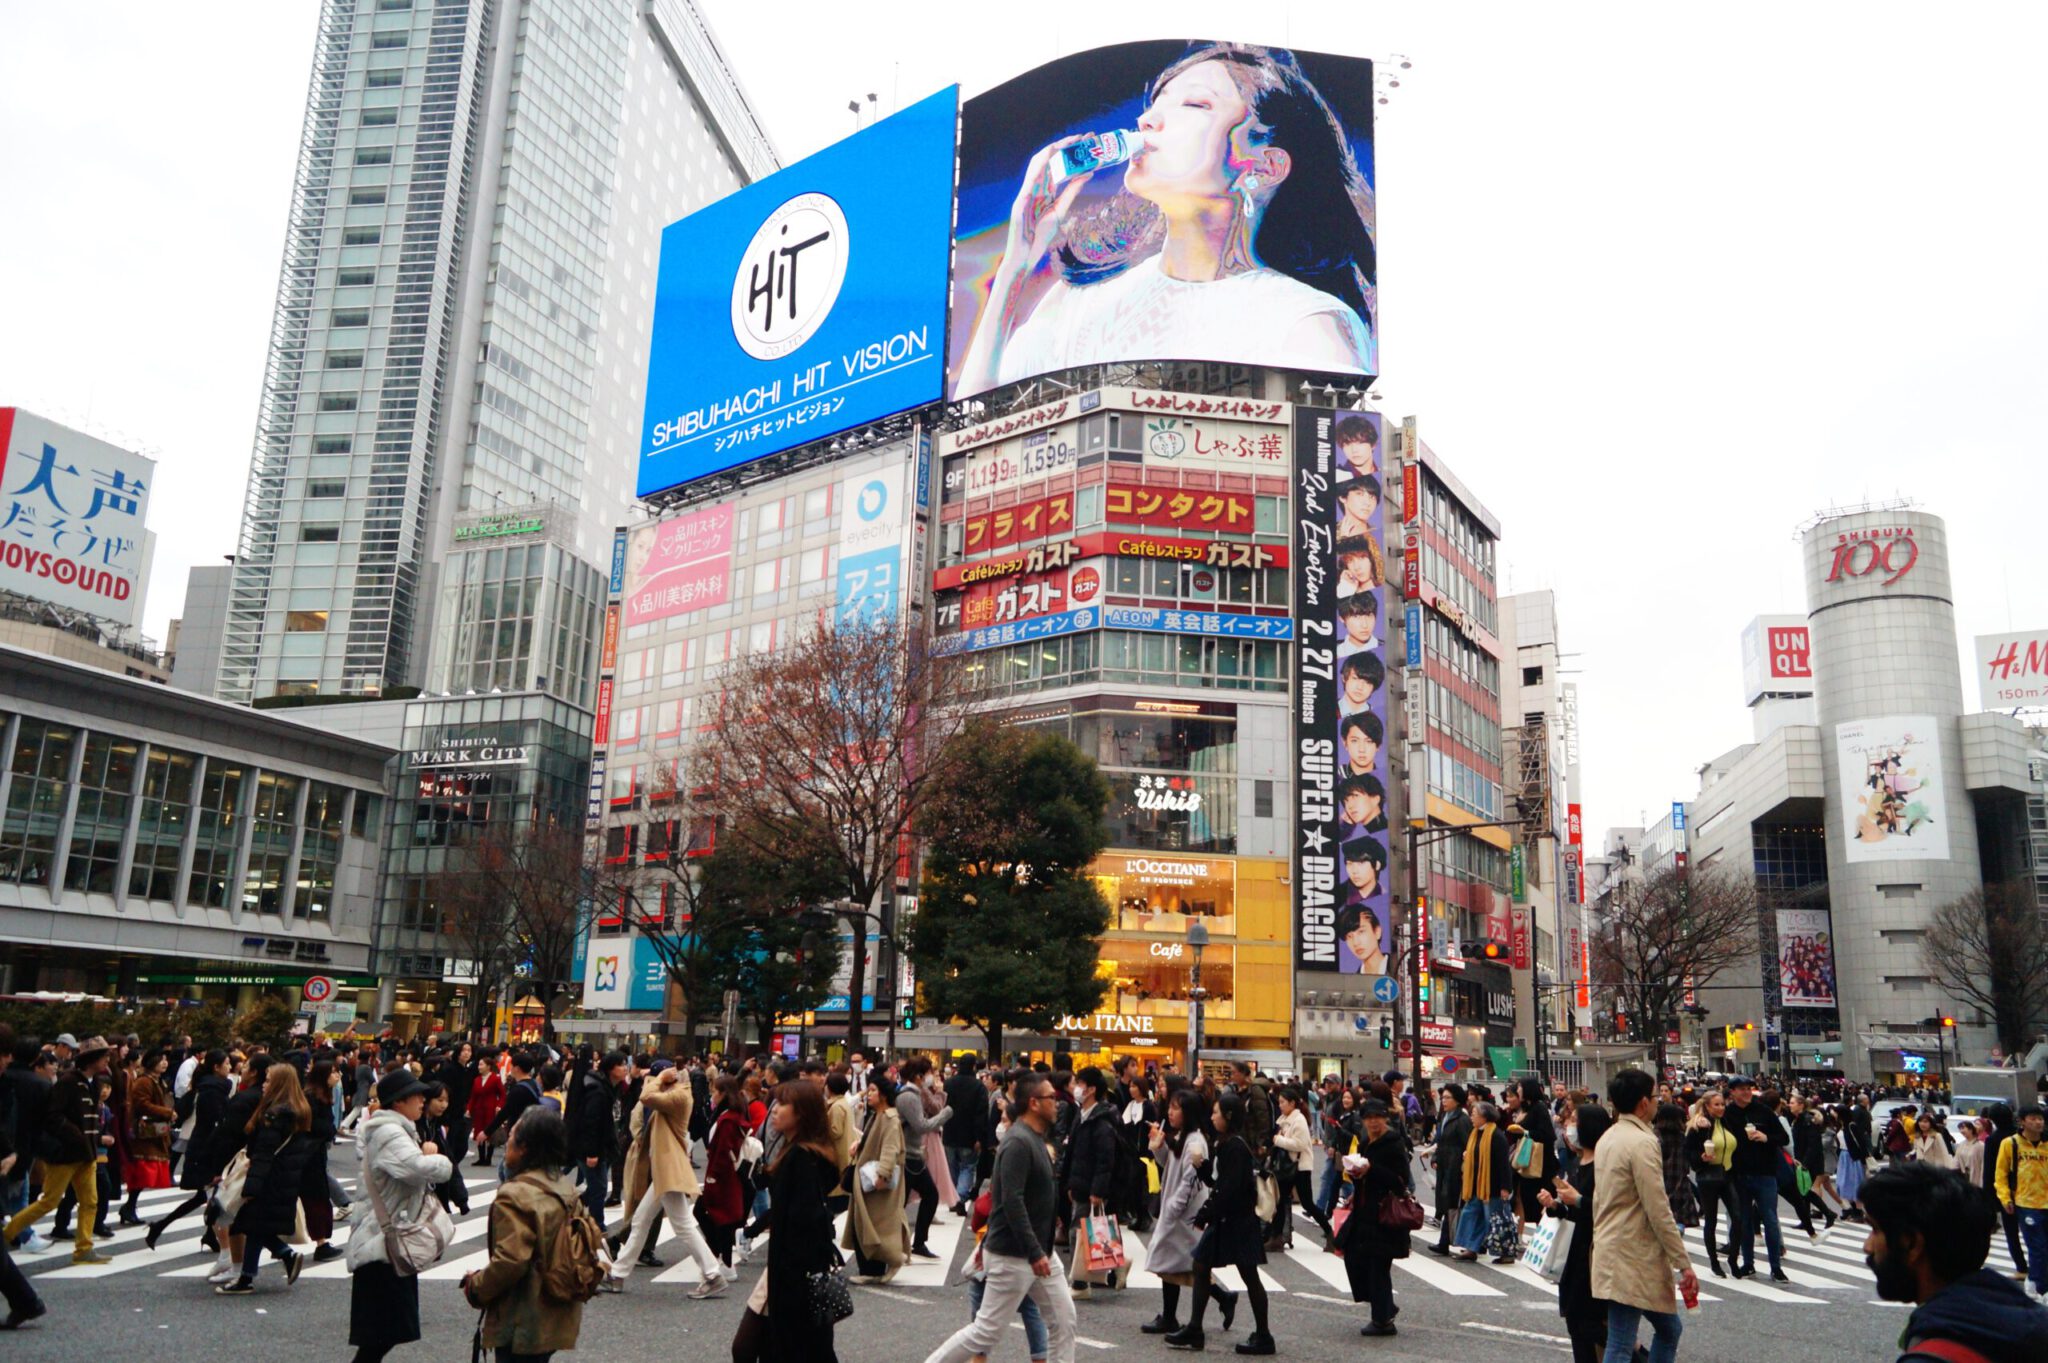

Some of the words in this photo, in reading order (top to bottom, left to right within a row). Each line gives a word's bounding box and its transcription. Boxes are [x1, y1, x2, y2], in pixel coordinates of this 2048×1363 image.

[652, 380, 781, 447] SHIBUHACHI
[793, 361, 832, 396] HIT
[842, 325, 928, 377] VISION
[1131, 391, 1283, 420] しゃぶしゃぶバイキング
[714, 396, 845, 452] シブハチヒットビジョン
[954, 401, 1069, 448] しゃぶしゃぶバイキング
[1317, 416, 1331, 440] New
[1194, 428, 1283, 460] しゃぶ葉
[1317, 441, 1331, 473] Album
[9, 442, 148, 520] 大声
[945, 469, 965, 489] 9F
[1301, 468, 1328, 515] 2nd
[967, 497, 1072, 546] プライス
[1107, 488, 1249, 524] コンタクト
[455, 525, 499, 539] MARK
[502, 518, 544, 533] CITY
[674, 513, 730, 541] 品川スキン
[847, 521, 895, 545] eyecity
[1838, 527, 1914, 543] SHIBUYA
[673, 535, 721, 559] クリニック
[960, 558, 1024, 583] Caféレストラン
[1026, 541, 1080, 573] ガスト
[1118, 539, 1202, 560] Caféレストラン
[1207, 541, 1273, 569] ガスト
[1301, 519, 1331, 606] Emotion
[1825, 537, 1919, 587] 109
[1074, 580, 1098, 594] ガスト
[1407, 562, 1418, 592] ガスト
[639, 575, 723, 614] 品川美容外科
[995, 581, 1062, 622] ガスト
[938, 603, 960, 625] 7F
[1109, 609, 1154, 625] AEON
[1164, 611, 1289, 636] 英会話イーオン
[974, 616, 1069, 648] 英会話イーオン
[1301, 619, 1333, 681] 2.27
[1988, 640, 2048, 681] H&M
[1301, 680, 1318, 724] Release
[1564, 689, 1576, 712] BIC
[441, 737, 498, 749] SHIBUYA
[1564, 712, 1579, 767] CAMERA
[411, 749, 472, 765] MARK
[480, 746, 531, 762] CITY
[1301, 738, 1334, 823] SUPER
[1126, 859, 1208, 877] L'OCCITANE
[1140, 876, 1152, 884] EN
[1153, 877, 1194, 885] PROVENCE
[1302, 855, 1336, 962] DRAGON
[1150, 942, 1183, 959] Café
[194, 975, 228, 984] SHIBUYA
[230, 976, 252, 984] MARK
[254, 977, 275, 985] CITY
[1487, 992, 1513, 1018] LUSH
